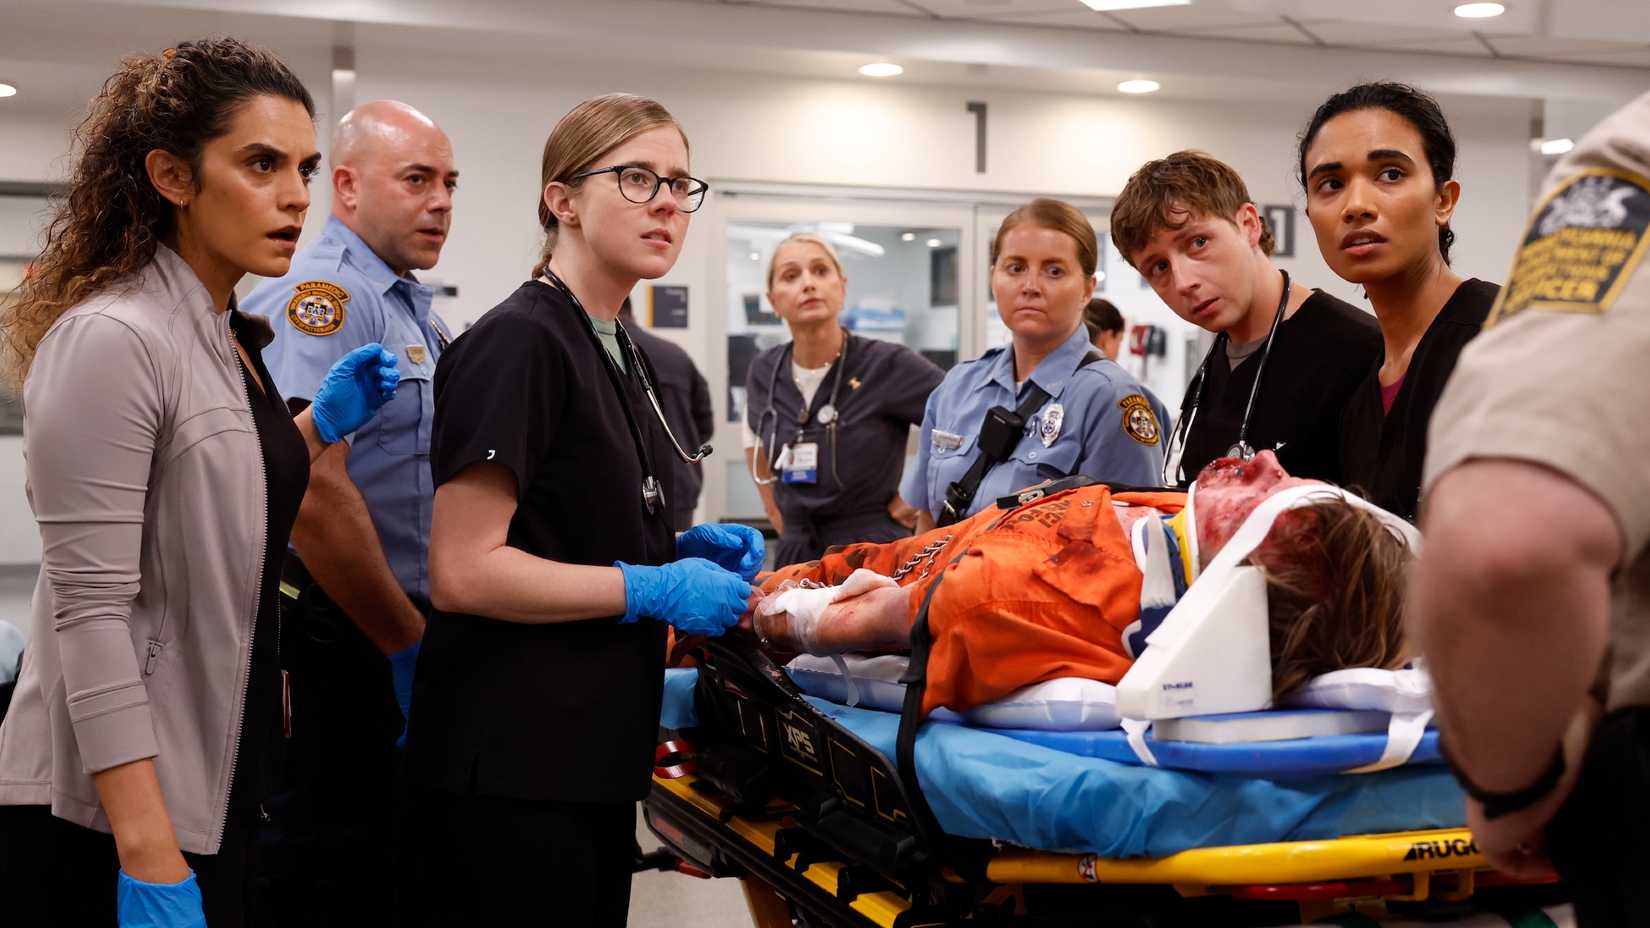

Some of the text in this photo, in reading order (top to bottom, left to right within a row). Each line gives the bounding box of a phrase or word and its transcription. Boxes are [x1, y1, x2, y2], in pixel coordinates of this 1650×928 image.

[967, 102, 987, 173] 1
[1270, 208, 1286, 252] 1
[783, 722, 815, 754] XPS
